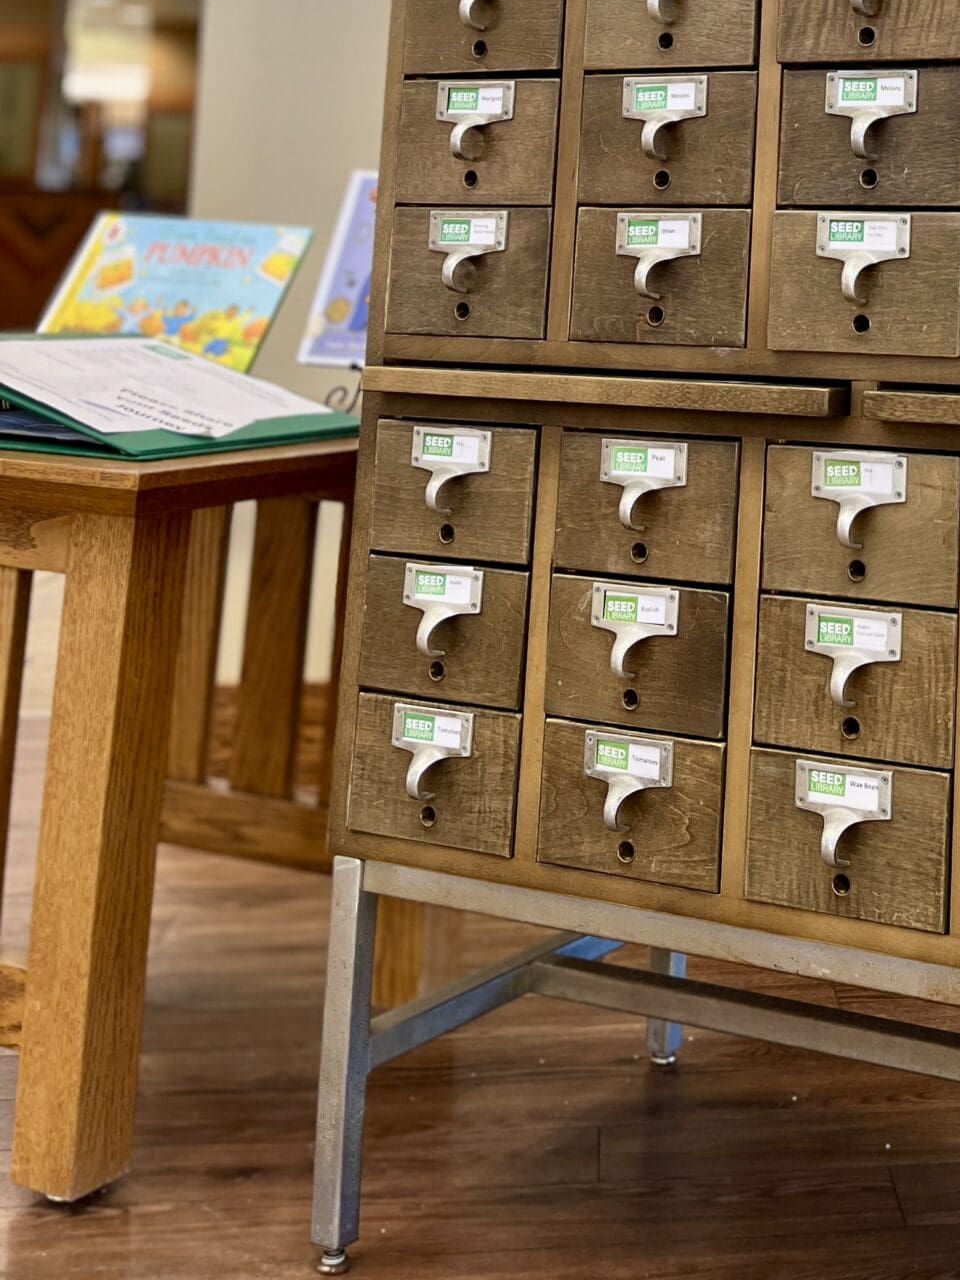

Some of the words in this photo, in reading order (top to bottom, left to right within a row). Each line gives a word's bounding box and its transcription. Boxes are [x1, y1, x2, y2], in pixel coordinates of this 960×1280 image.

[844, 81, 875, 92] SEED
[451, 92, 477, 101] SEED
[638, 91, 664, 101] SEED
[843, 91, 875, 100] LIBRARY
[443, 224, 469, 234] SEED
[629, 226, 656, 236] SEED
[830, 222, 861, 232] SEED
[830, 232, 863, 240] LIBRARY
[425, 437, 451, 447] SEED
[424, 446, 452, 455] LIBRARY
[616, 452, 644, 462] SEED
[616, 462, 646, 471] LIBRARY
[826, 466, 858, 476] SEED
[826, 476, 860, 485] LIBRARY
[418, 575, 443, 585] SEED
[608, 601, 635, 612] SEED
[819, 621, 851, 634] SEED
[819, 632, 853, 643] LIBRARY
[406, 718, 433, 731] SEED
[405, 729, 433, 739] LIBRARY
[598, 744, 626, 758] SEED
[598, 756, 626, 768] LIBRARY
[632, 755, 658, 765] Tomatoes
[811, 772, 842, 785] SEED
[810, 782, 844, 795] LIBRARY
[850, 780, 863, 788] Wax
